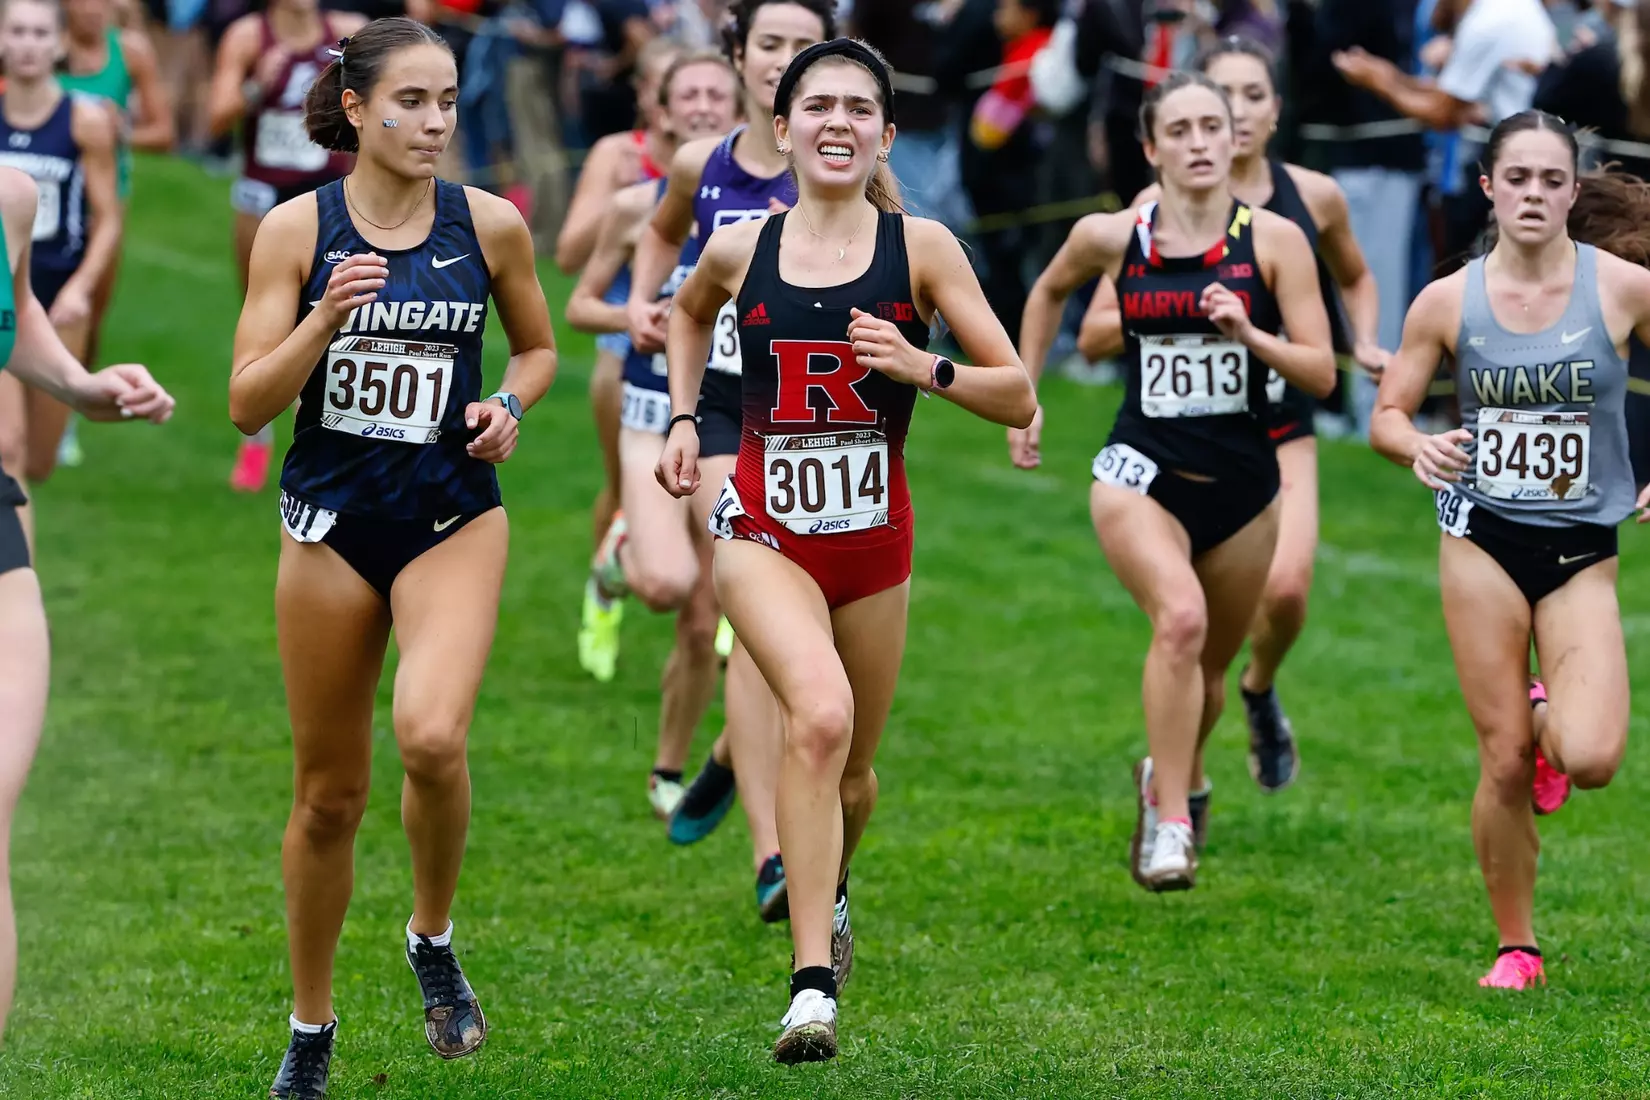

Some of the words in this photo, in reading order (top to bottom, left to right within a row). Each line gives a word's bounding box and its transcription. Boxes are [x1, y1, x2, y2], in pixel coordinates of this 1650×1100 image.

[327, 250, 350, 260] SAC
[1123, 291, 1252, 319] MARYLD
[370, 341, 407, 354] LEHIGH
[422, 350, 438, 358] Short
[424, 344, 440, 352] 2023
[329, 358, 444, 421] 3501
[770, 339, 878, 425] R
[1147, 352, 1243, 397] 2613
[1469, 360, 1595, 405] WAKE
[801, 436, 837, 448] LEHIGH
[1481, 429, 1583, 480] 3439
[769, 451, 885, 514] 3014
